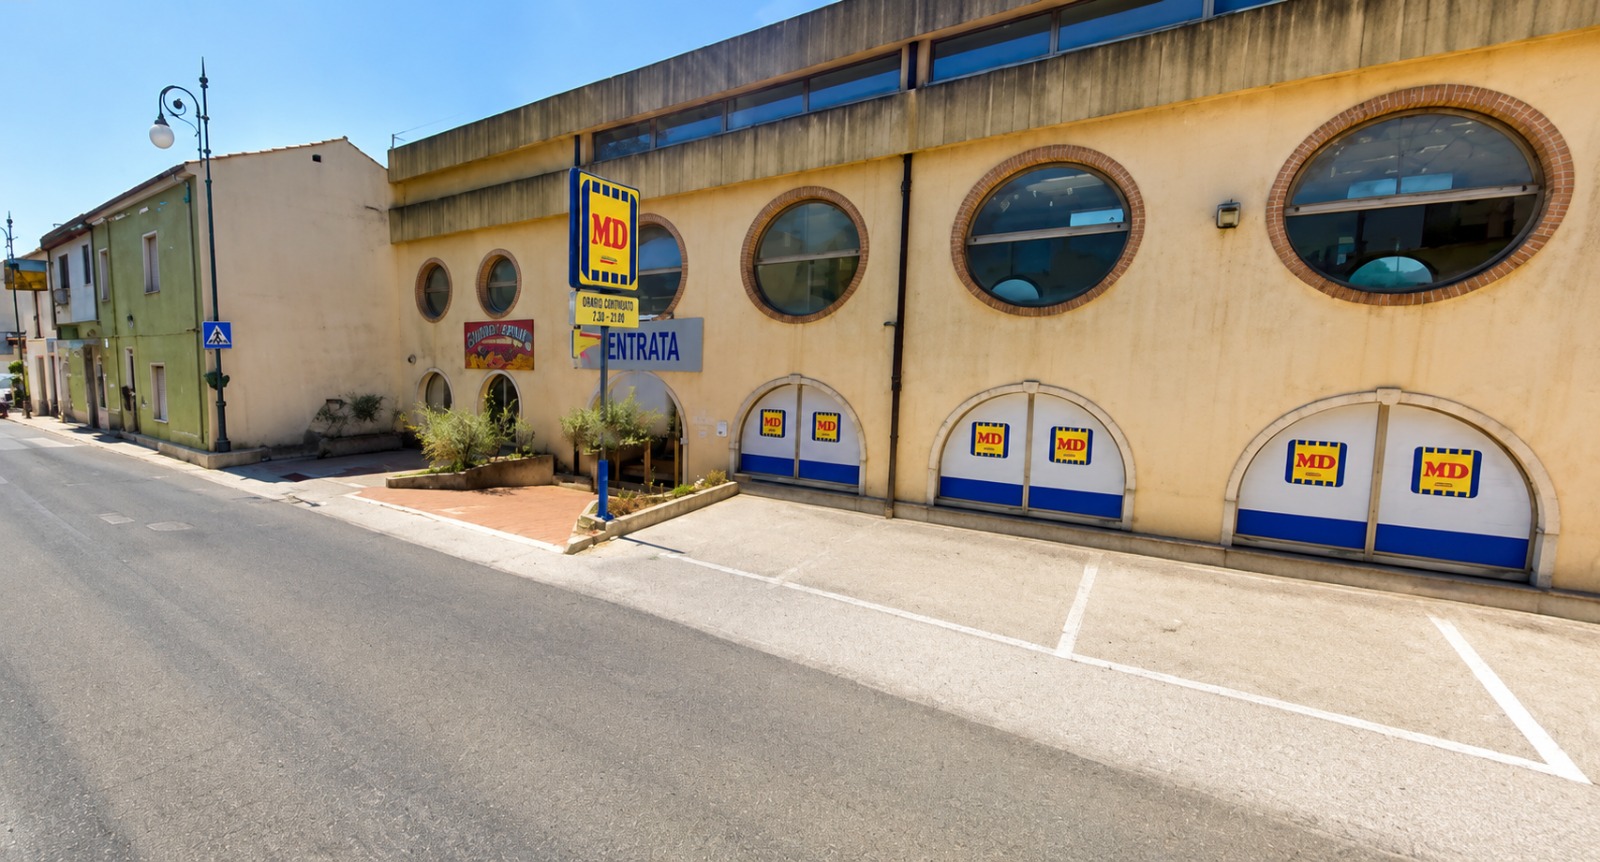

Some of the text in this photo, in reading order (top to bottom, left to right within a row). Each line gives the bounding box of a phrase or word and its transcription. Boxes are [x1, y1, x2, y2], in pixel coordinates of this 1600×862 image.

[591, 213, 628, 250] MD
[607, 331, 680, 361] ENTRATA
[764, 417, 781, 428] MD
[817, 420, 836, 432] MD
[977, 432, 1003, 445] MD
[1057, 437, 1086, 452] MD
[1295, 453, 1337, 469] MD
[1423, 461, 1470, 479] MD
